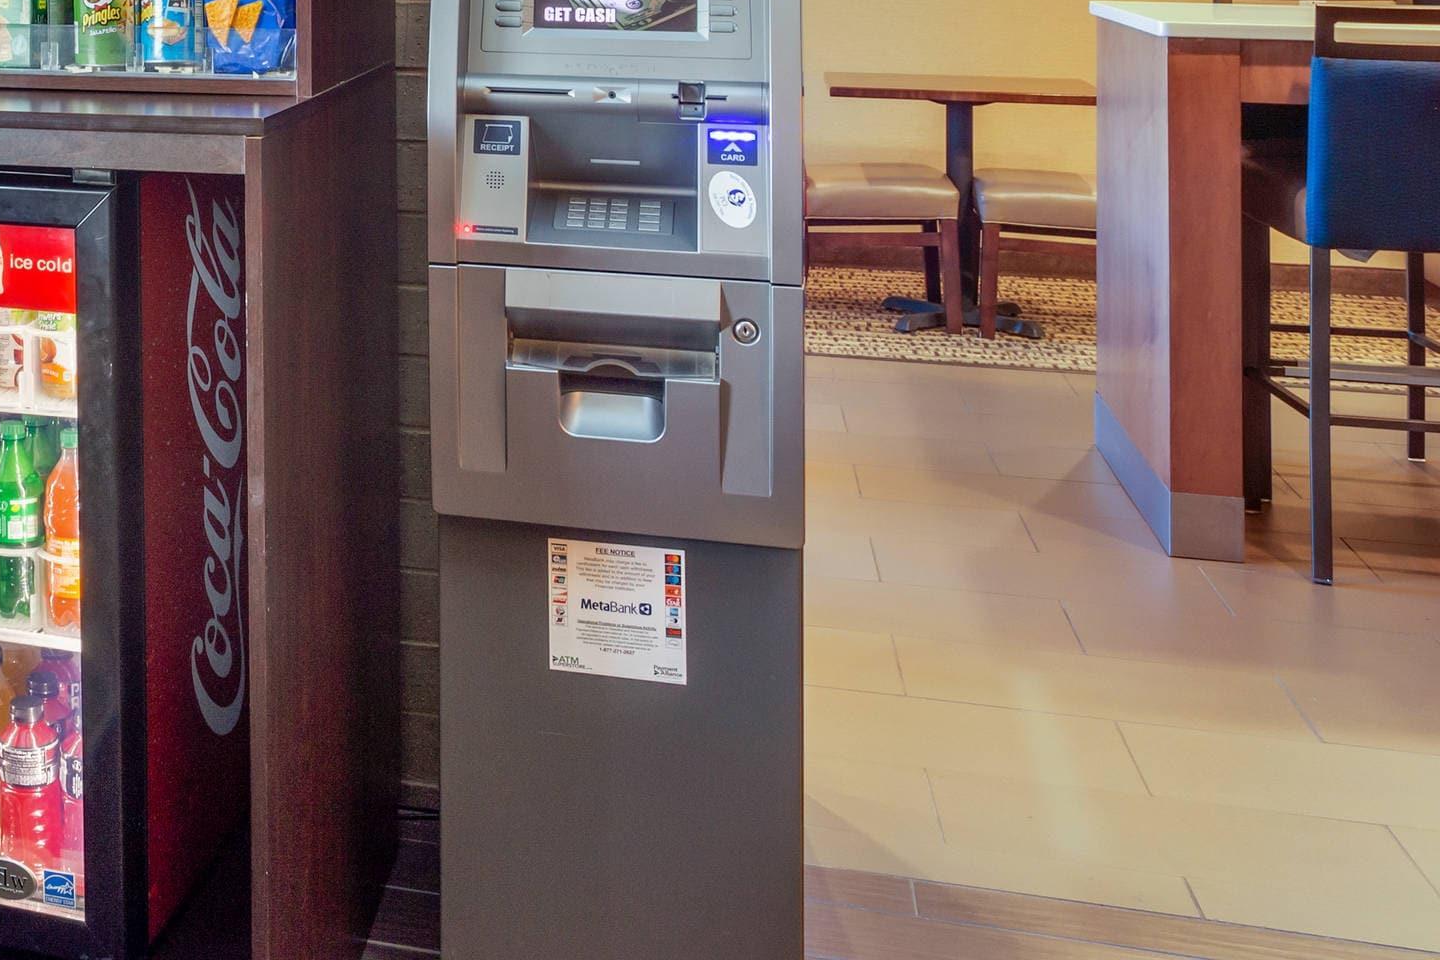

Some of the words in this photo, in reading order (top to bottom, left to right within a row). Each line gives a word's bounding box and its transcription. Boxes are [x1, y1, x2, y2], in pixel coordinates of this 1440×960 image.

[82, 6, 121, 32] Pringles
[543, 6, 572, 23] GET
[575, 6, 616, 24] CASH
[480, 143, 515, 152] RECEIPT
[720, 153, 745, 162] CARD
[10, 252, 34, 270] ice
[36, 256, 73, 274] cold
[186, 176, 246, 737] Coca-Cola
[595, 547, 608, 555] FEE
[610, 548, 636, 558] NOTICE
[580, 598, 639, 615] MetaBank
[560, 655, 579, 665] ATM
